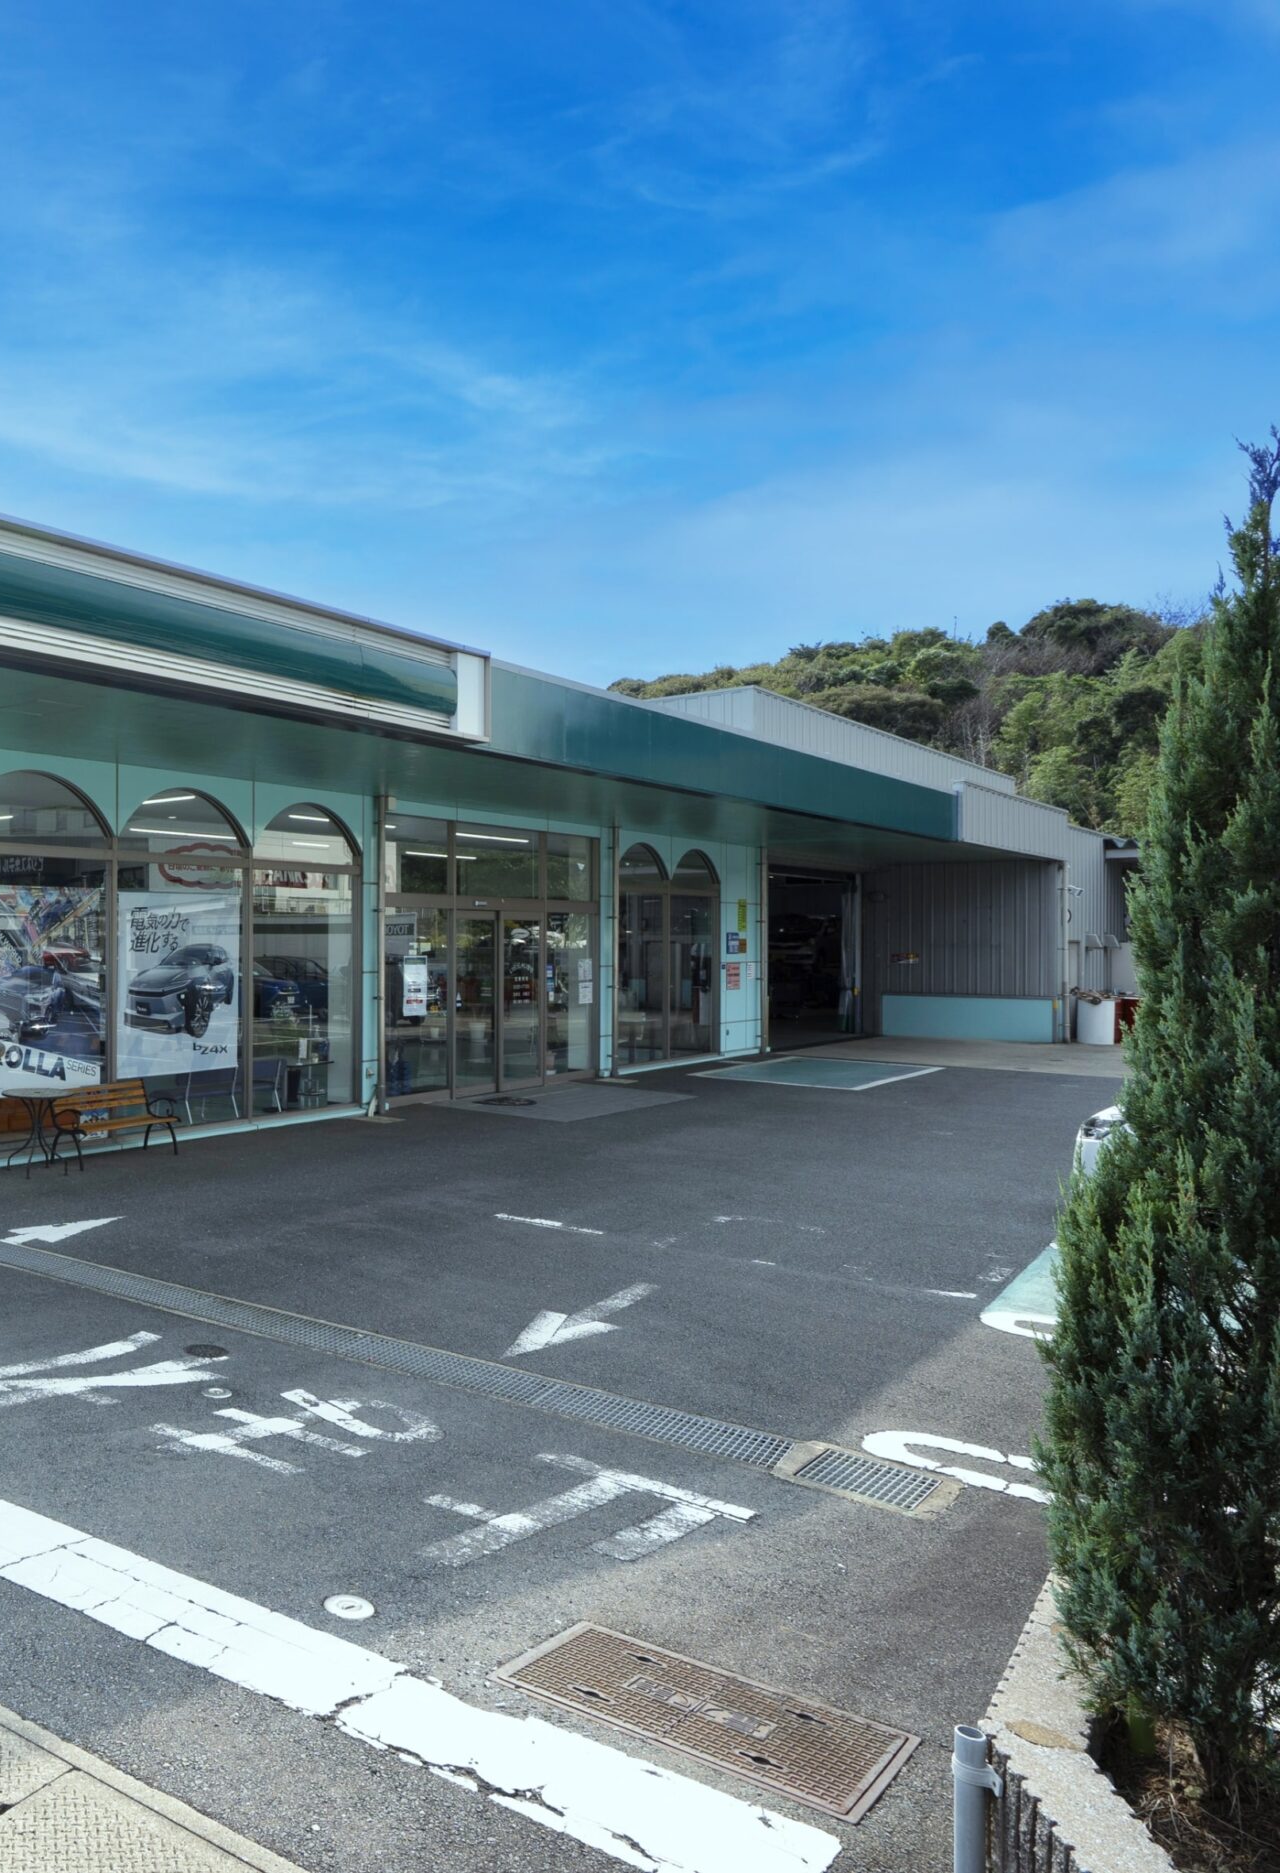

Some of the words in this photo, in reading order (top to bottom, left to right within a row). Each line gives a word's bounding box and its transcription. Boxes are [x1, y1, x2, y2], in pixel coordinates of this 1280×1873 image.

[130, 907, 190, 931] 電気の力で
[129, 931, 179, 954] 進化する
[66, 1058, 97, 1077] SERIES
